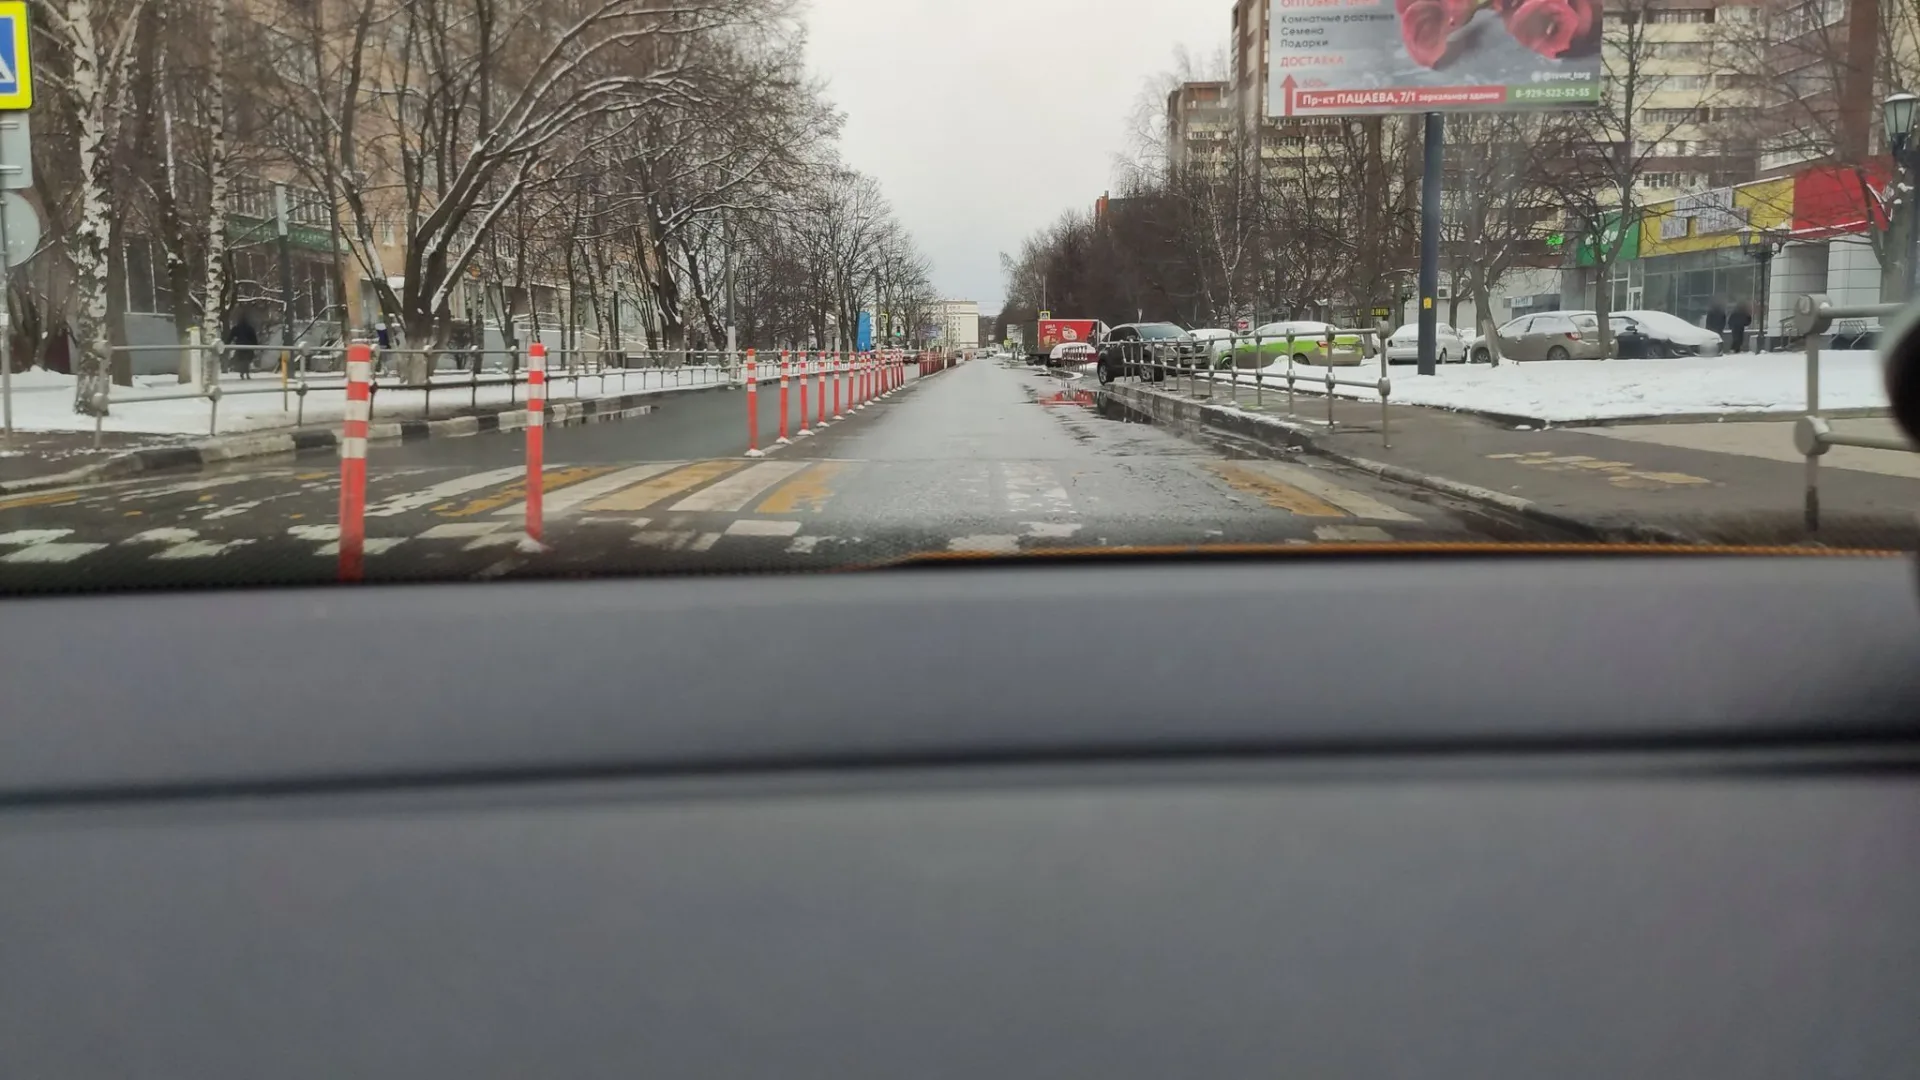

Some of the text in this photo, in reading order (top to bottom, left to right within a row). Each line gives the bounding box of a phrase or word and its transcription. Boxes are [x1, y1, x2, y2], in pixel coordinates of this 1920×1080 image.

[1281, 15, 1341, 23] Комнатные
[1281, 27, 1324, 36] Семена
[1281, 39, 1328, 49] Подарки
[1281, 56, 1344, 67] ДОСТАВКА
[1302, 94, 1335, 106] Пр-кт
[1337, 91, 1399, 105] ПАЦАЕВА,
[1400, 90, 1416, 103] 7/1
